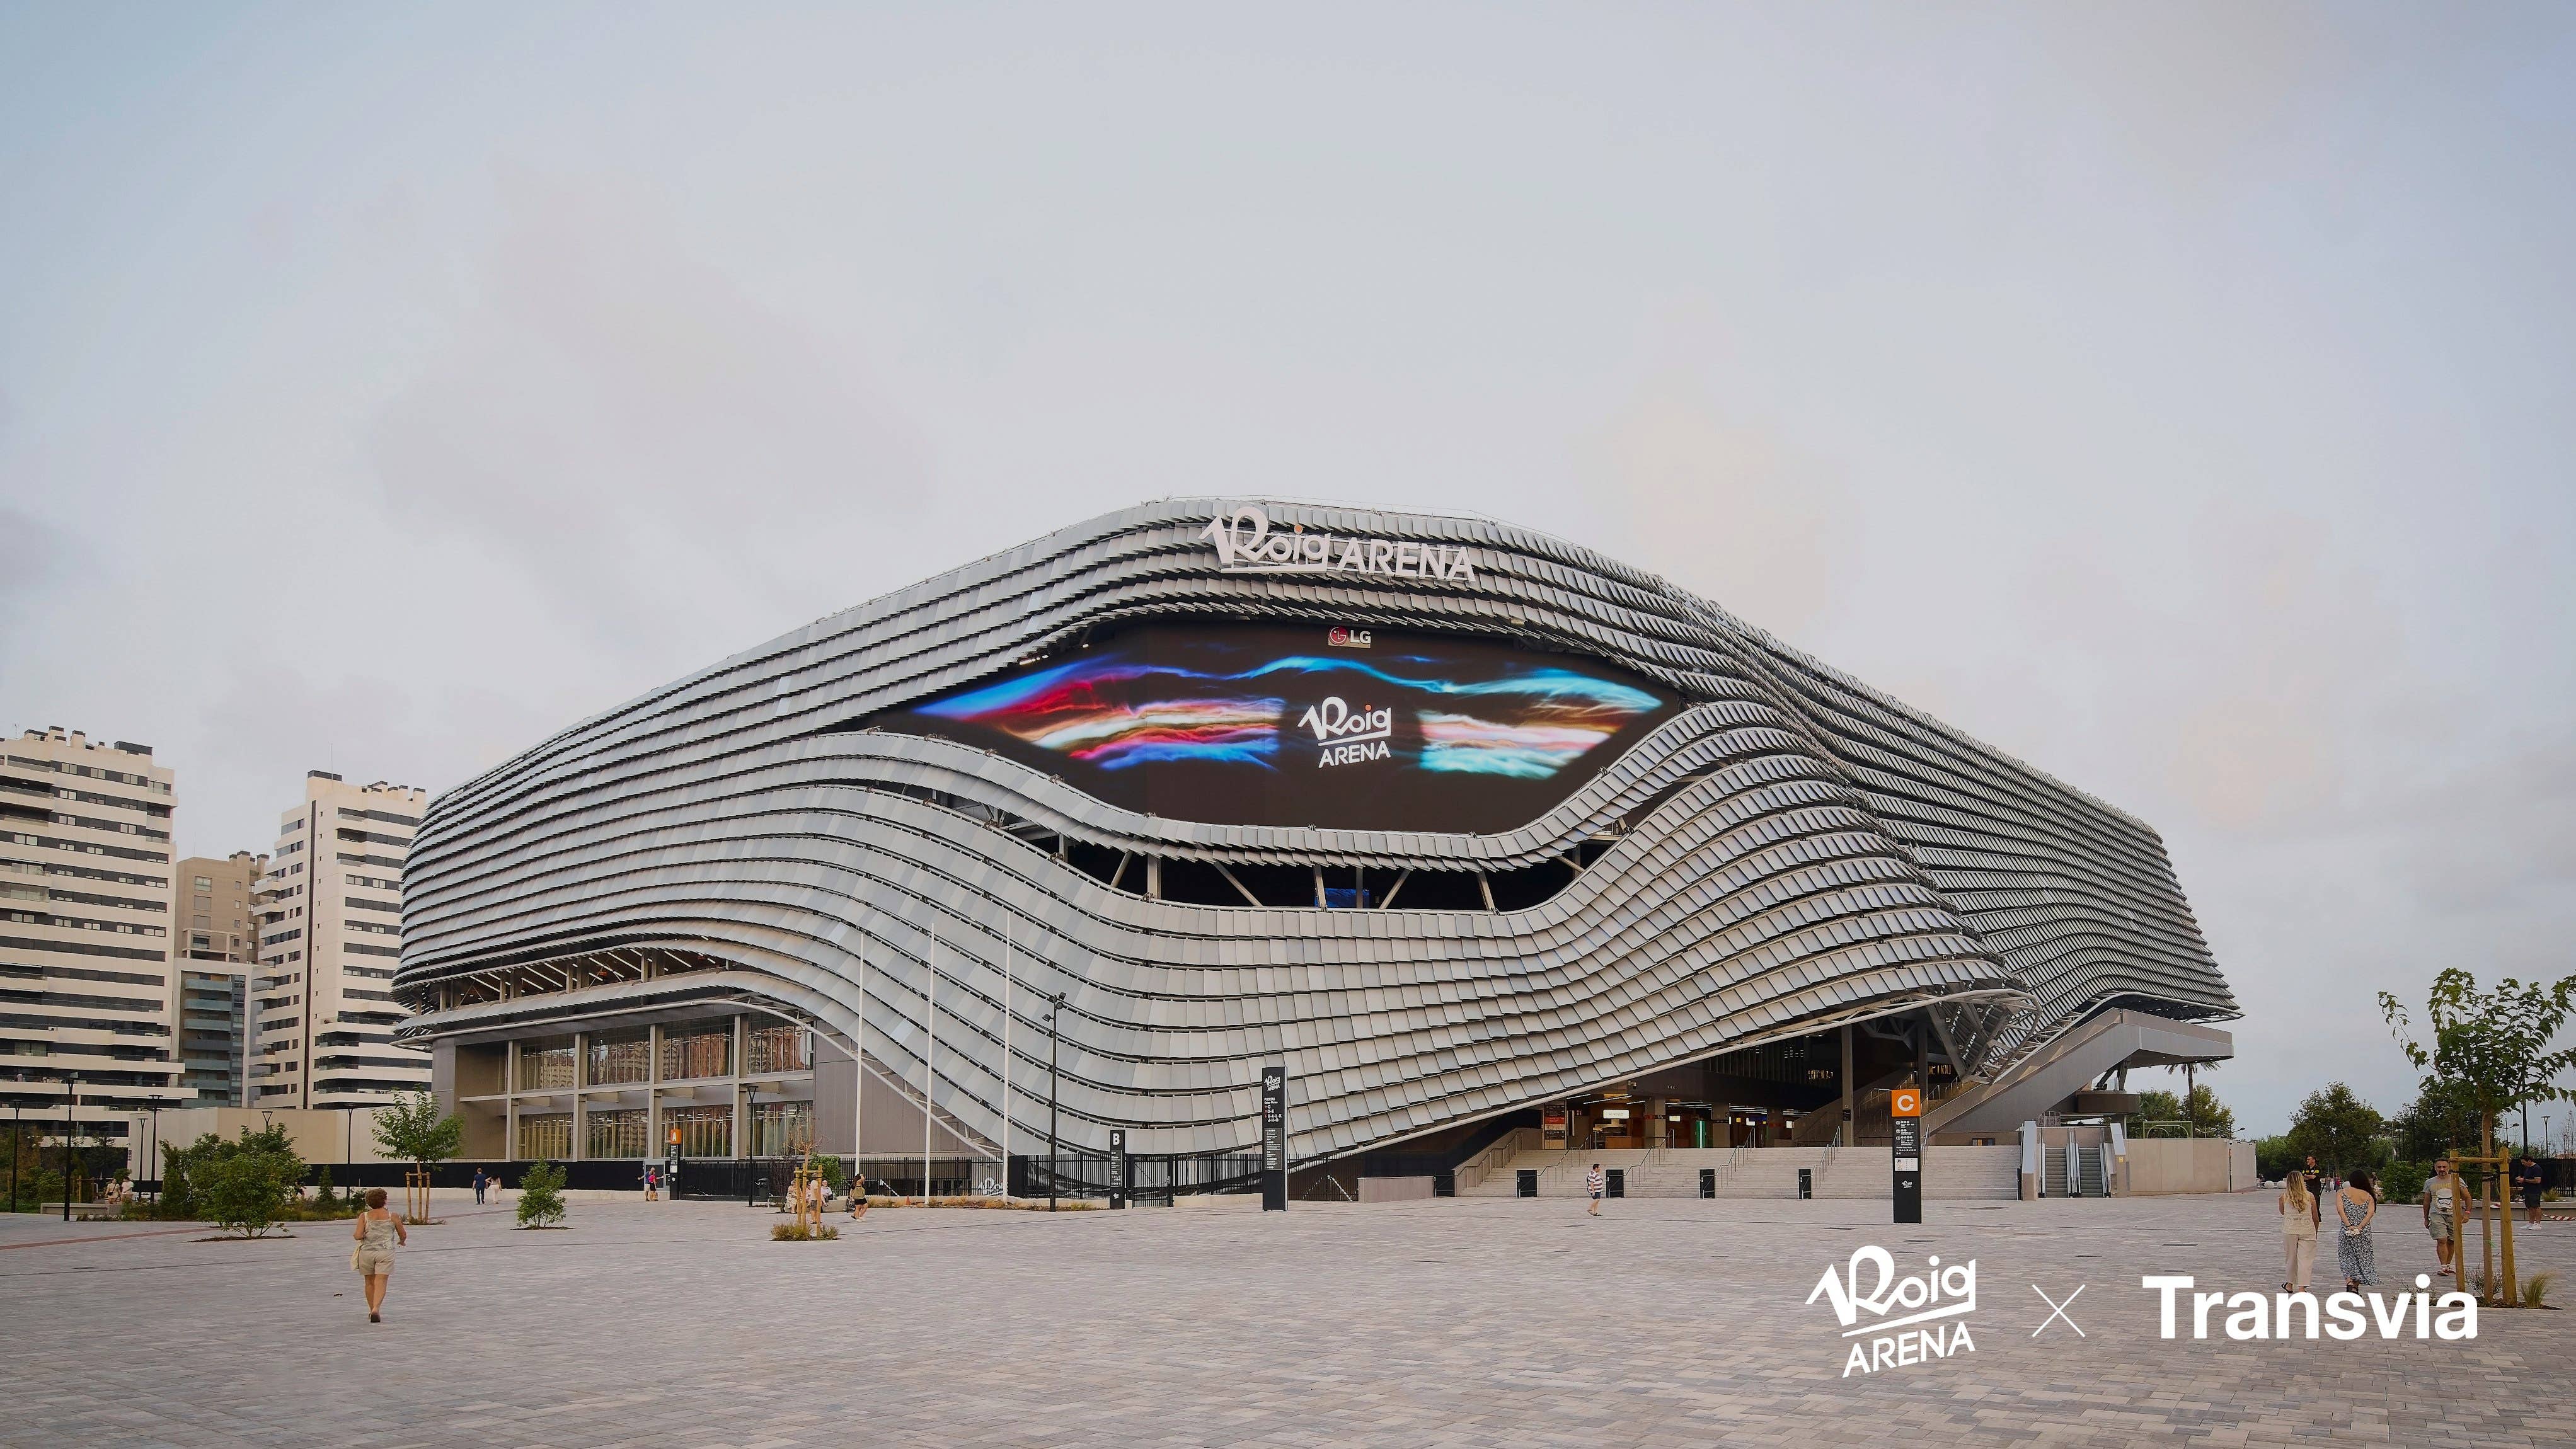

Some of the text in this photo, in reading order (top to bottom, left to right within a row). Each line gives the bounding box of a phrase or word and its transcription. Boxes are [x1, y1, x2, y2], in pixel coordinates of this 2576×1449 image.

[1198, 506, 1476, 582] Roig ARENA
[1349, 629, 1371, 644] LG
[1297, 696, 1391, 747] Roig
[1318, 740, 1391, 769] ARENA
[1267, 1084, 1280, 1092] ARENA
[1897, 1094, 1914, 1111] C
[672, 1132, 677, 1141] A
[1113, 1133, 1120, 1145] B
